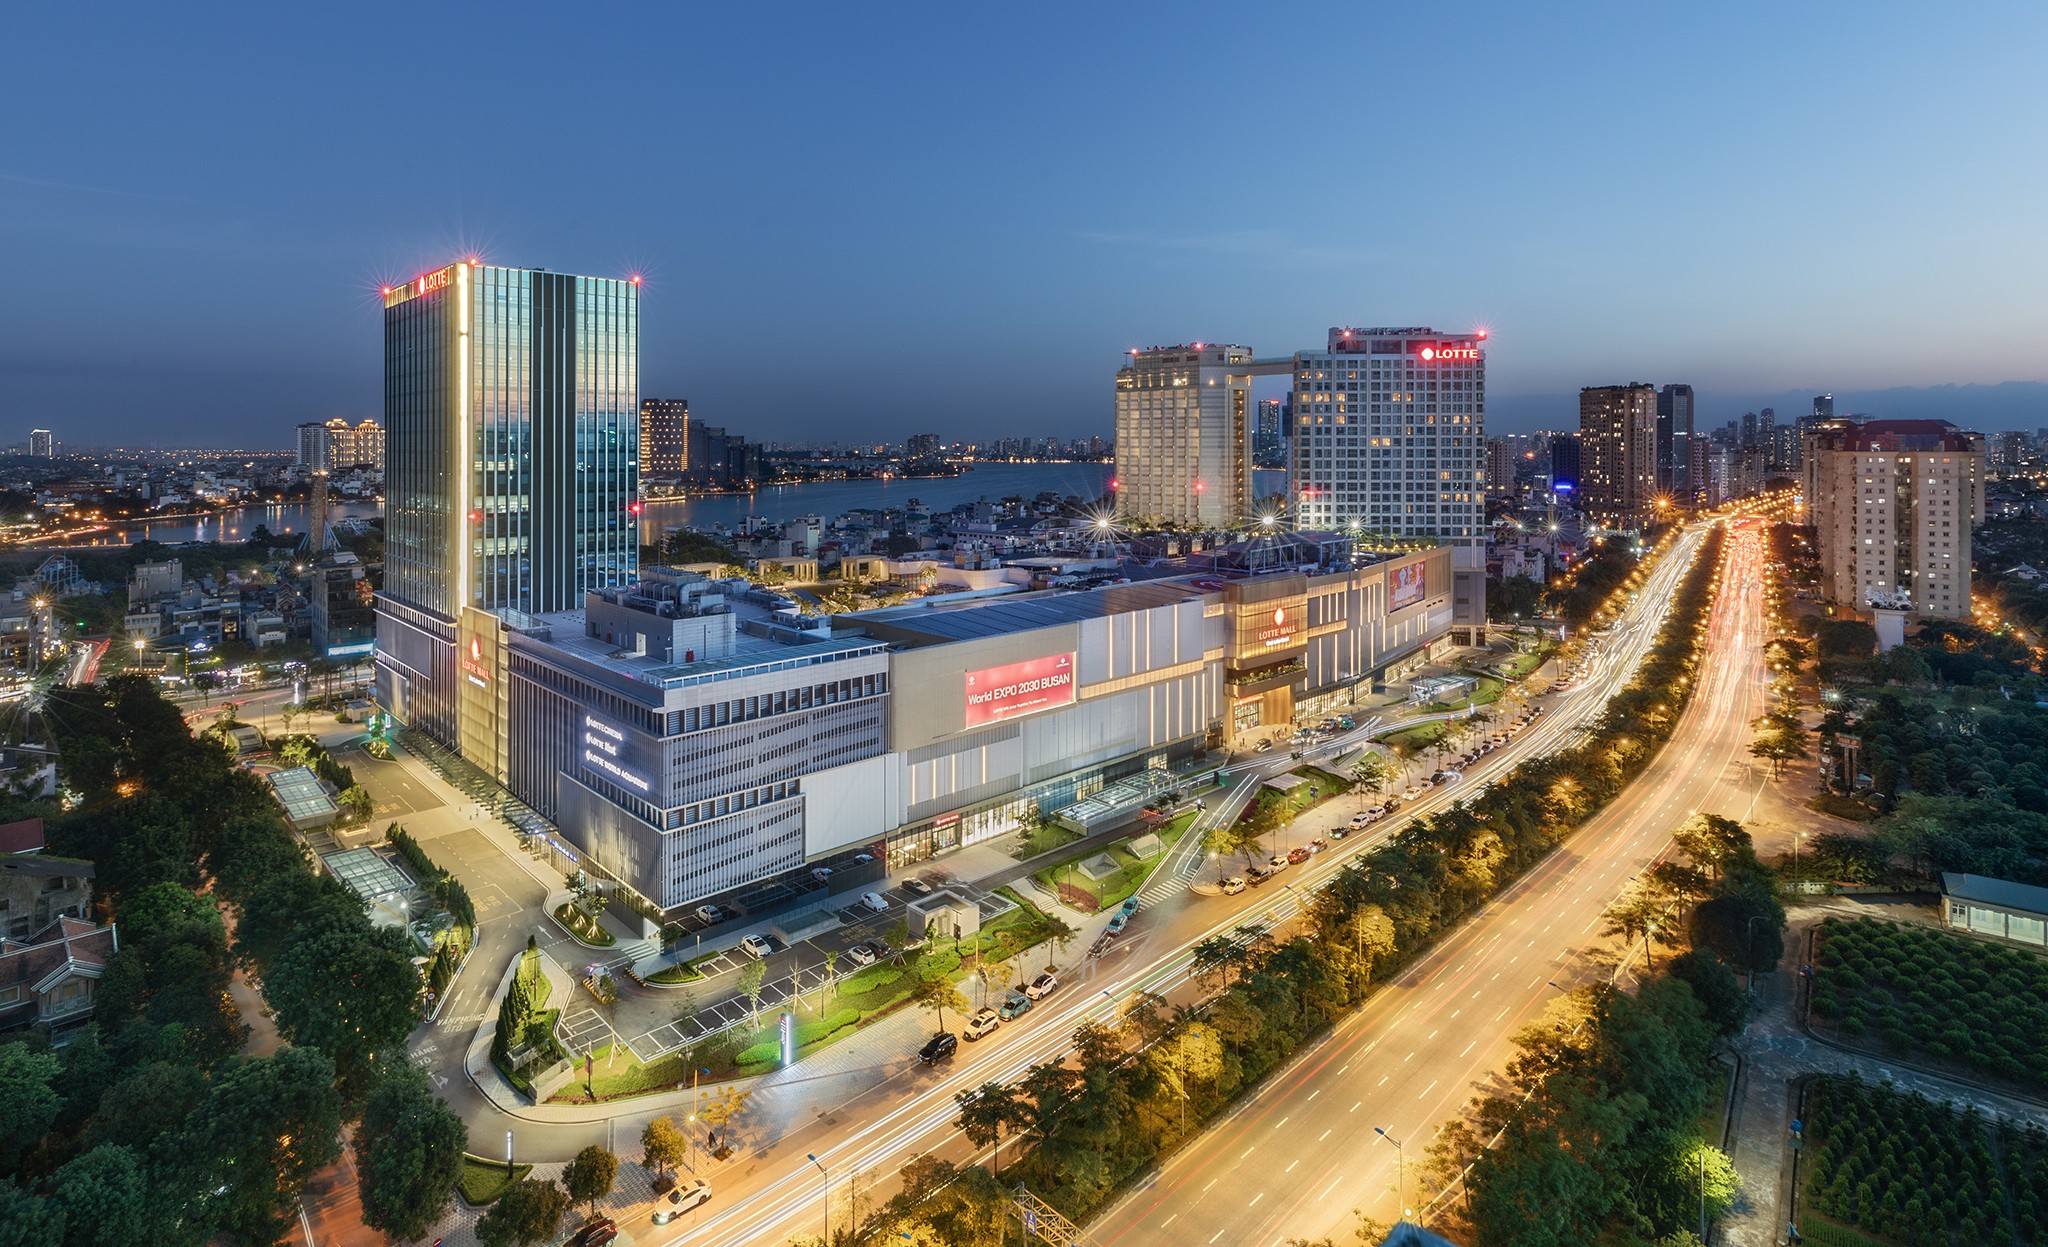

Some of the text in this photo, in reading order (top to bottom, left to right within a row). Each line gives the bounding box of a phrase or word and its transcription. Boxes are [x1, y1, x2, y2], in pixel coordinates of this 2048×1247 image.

[425, 269, 446, 289] LOTTE
[1435, 349, 1478, 359] LOTTE
[1259, 625, 1297, 640] LOTTE MALL
[462, 659, 491, 680] LOTTE MALL
[968, 673, 1070, 705] World EXPO 2030 BUSAN
